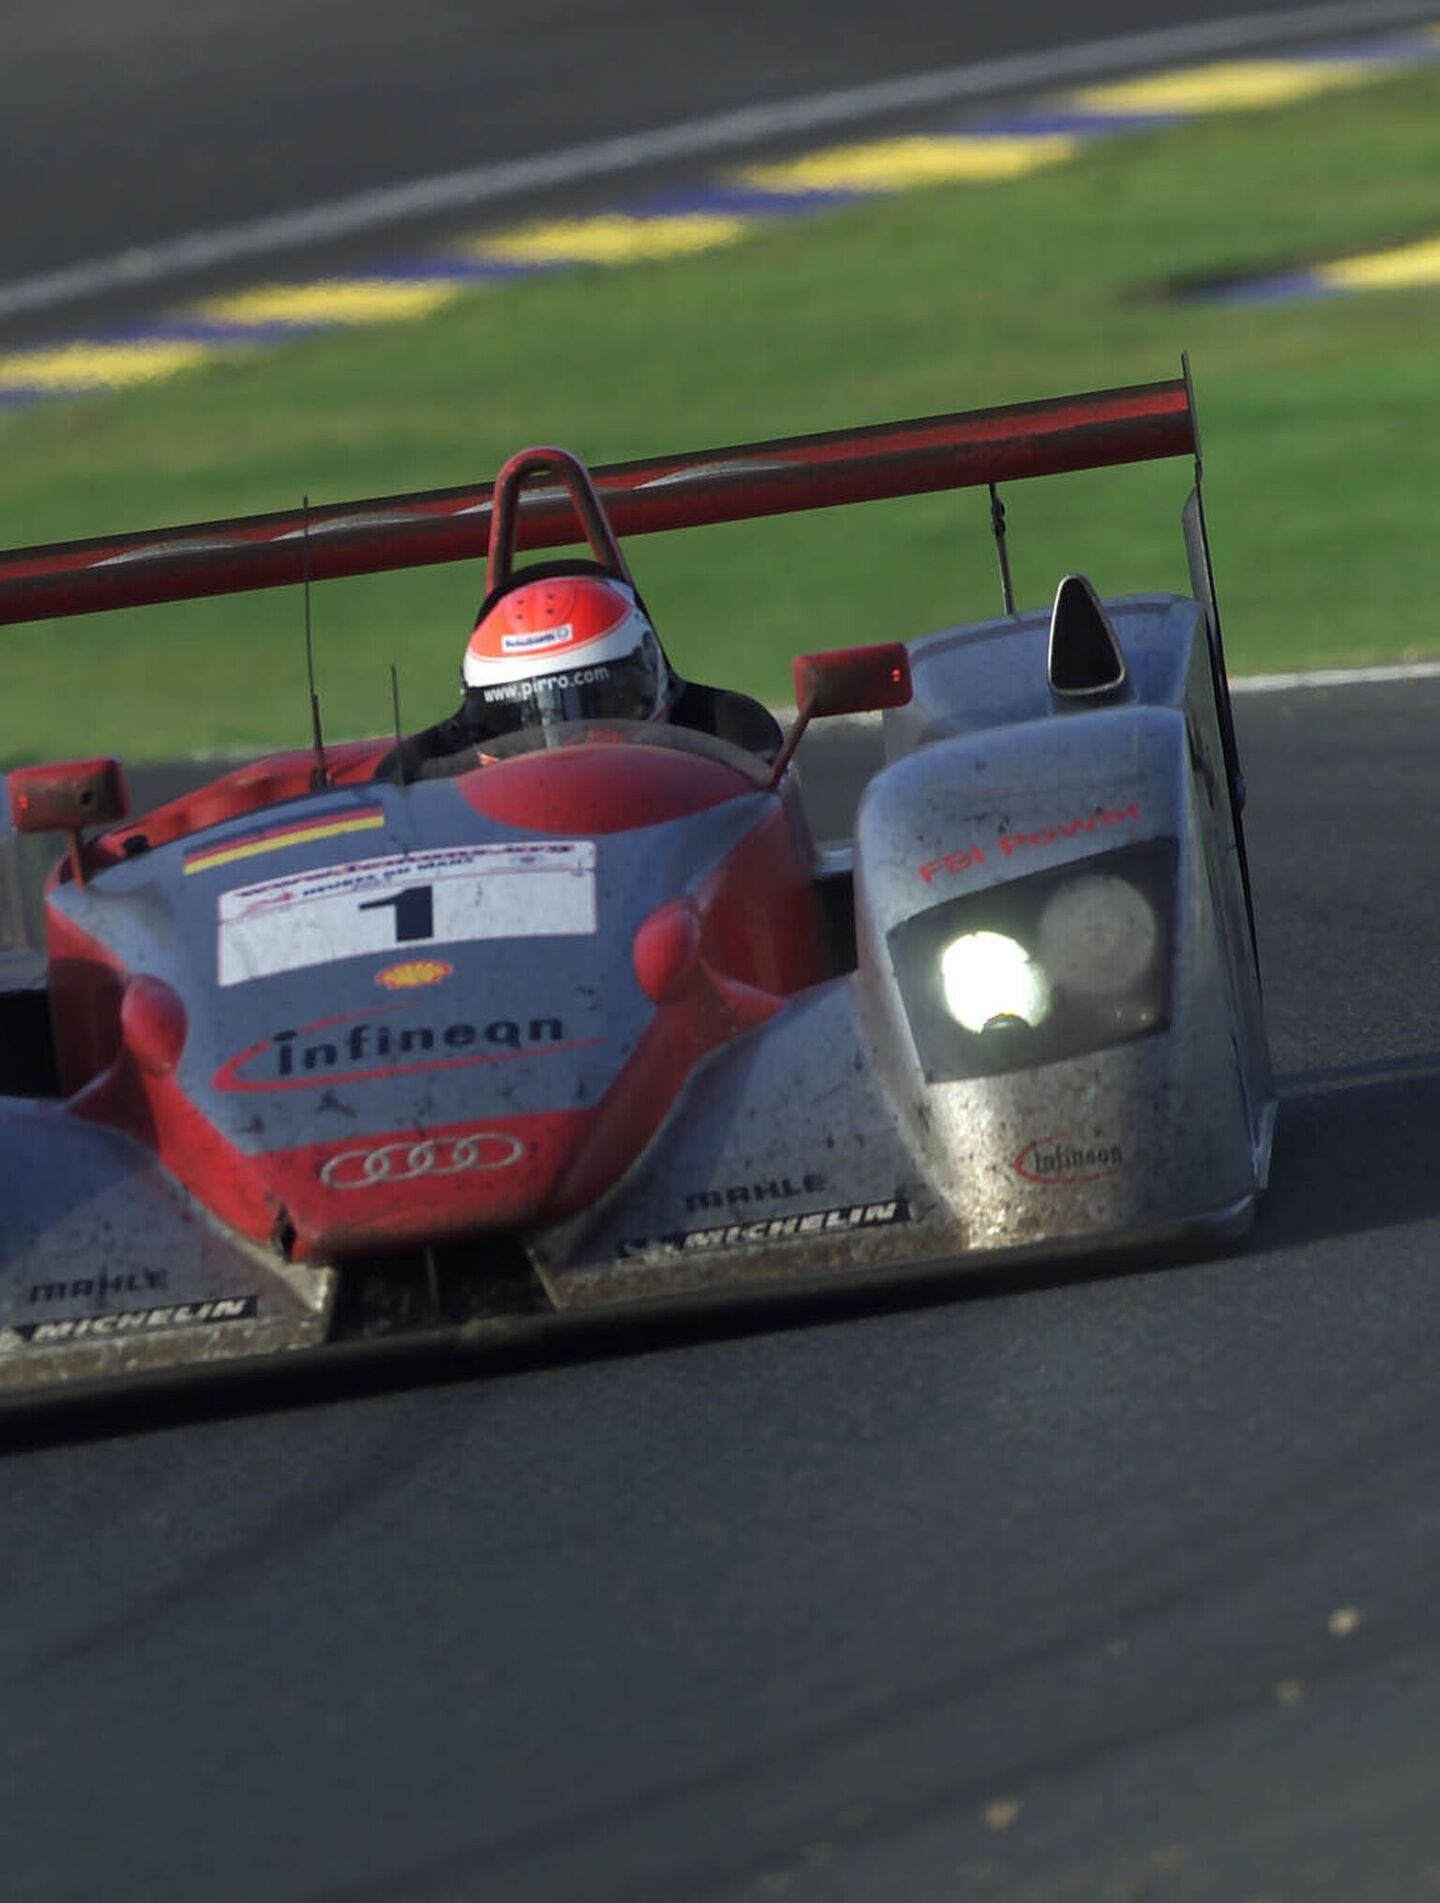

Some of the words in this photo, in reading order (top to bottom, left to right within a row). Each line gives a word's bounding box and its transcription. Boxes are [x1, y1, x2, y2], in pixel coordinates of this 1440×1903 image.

[483, 665, 610, 704] www.pirro.com
[998, 802, 1139, 857] Power
[359, 884, 434, 942] 1
[685, 1173, 826, 1212] MAHLE
[682, 1201, 898, 1250] MICHELIN
[29, 1267, 168, 1306] MAHLE
[32, 1298, 247, 1343] MICHELIN
